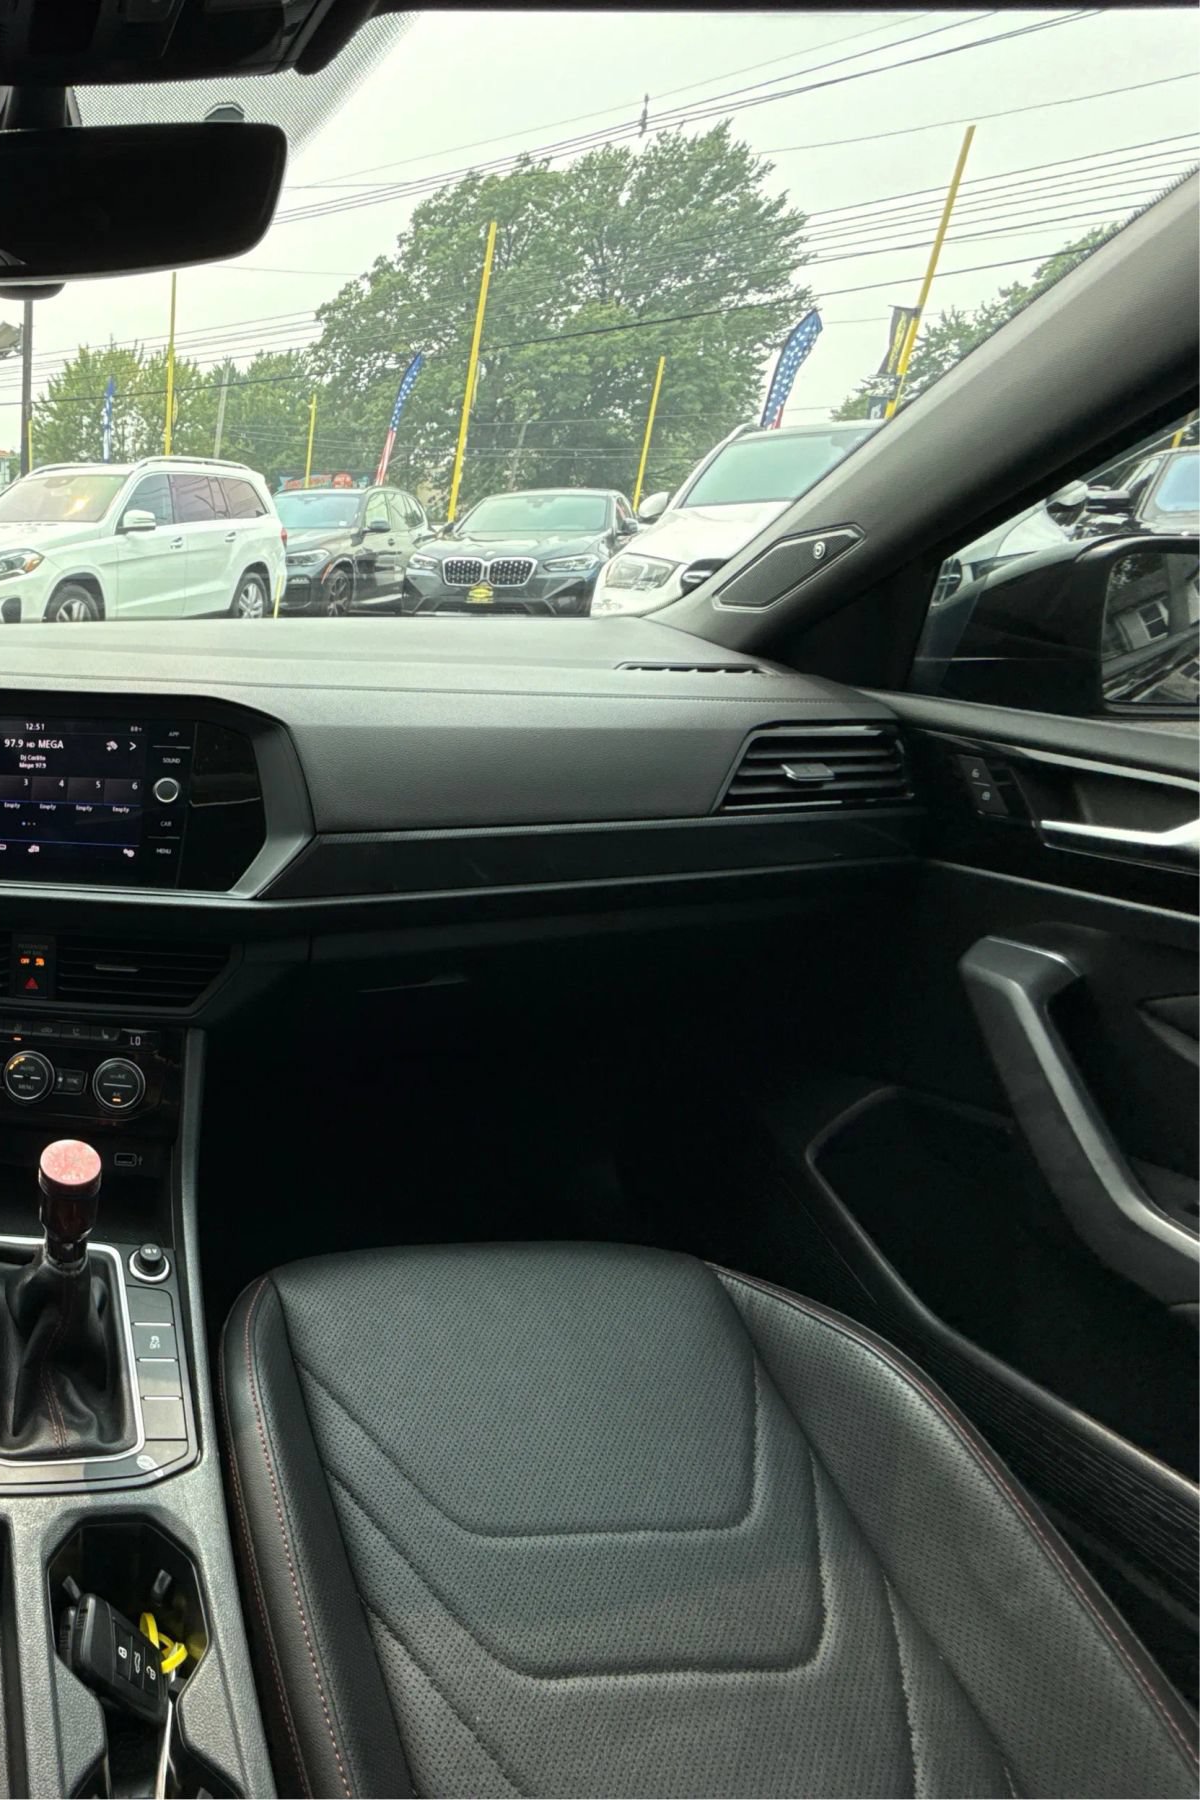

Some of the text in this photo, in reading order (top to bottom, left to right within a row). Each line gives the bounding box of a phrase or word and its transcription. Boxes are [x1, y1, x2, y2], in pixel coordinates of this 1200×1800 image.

[25, 723, 45, 731] 12:51
[4, 738, 24, 748] 97.9
[38, 739, 64, 749] MEGA
[23, 778, 29, 786] 3
[58, 779, 65, 787] 4
[131, 781, 138, 790] 6
[4, 801, 20, 809] Empty
[39, 803, 57, 811] Empty
[75, 805, 93, 813] Empty
[112, 806, 130, 814] Empty
[130, 1036, 141, 1046] LO
